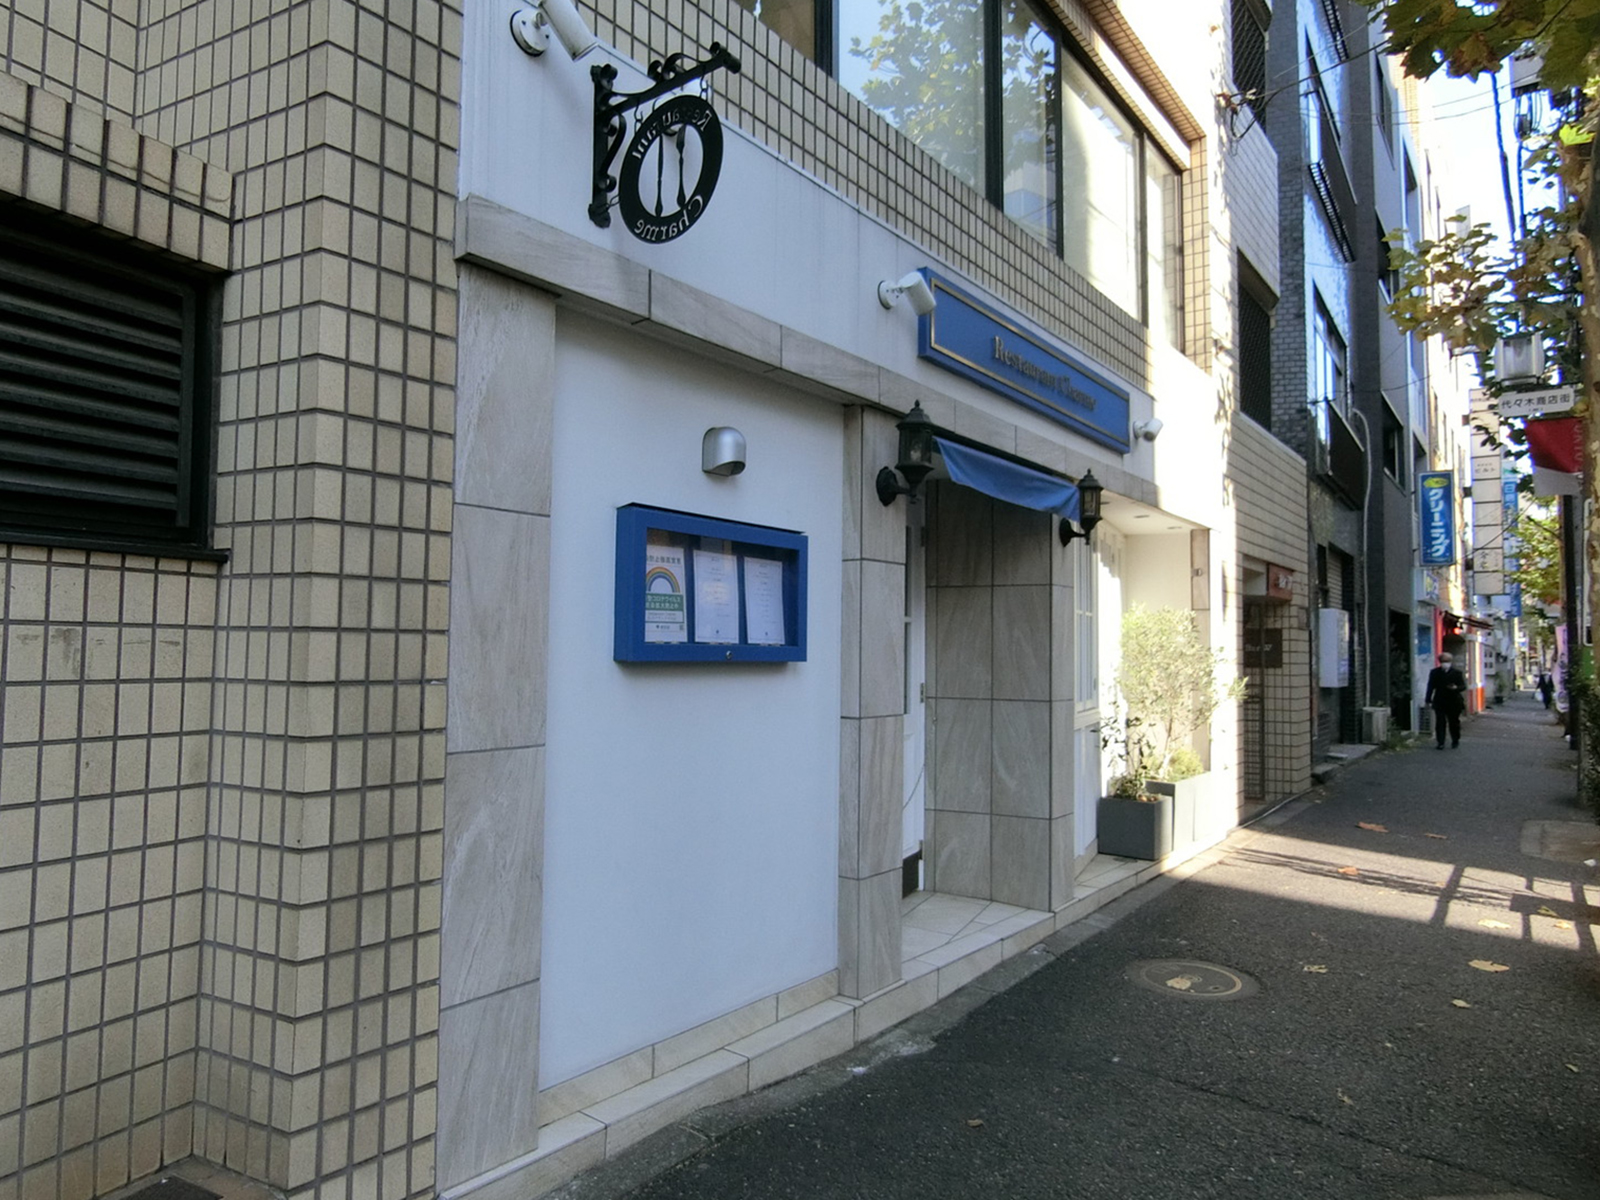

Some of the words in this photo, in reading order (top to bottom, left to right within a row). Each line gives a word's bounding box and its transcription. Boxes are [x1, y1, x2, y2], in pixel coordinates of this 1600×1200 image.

[1500, 394, 1571, 409] 代々木商店街
[1427, 488, 1451, 557] クリーニング
